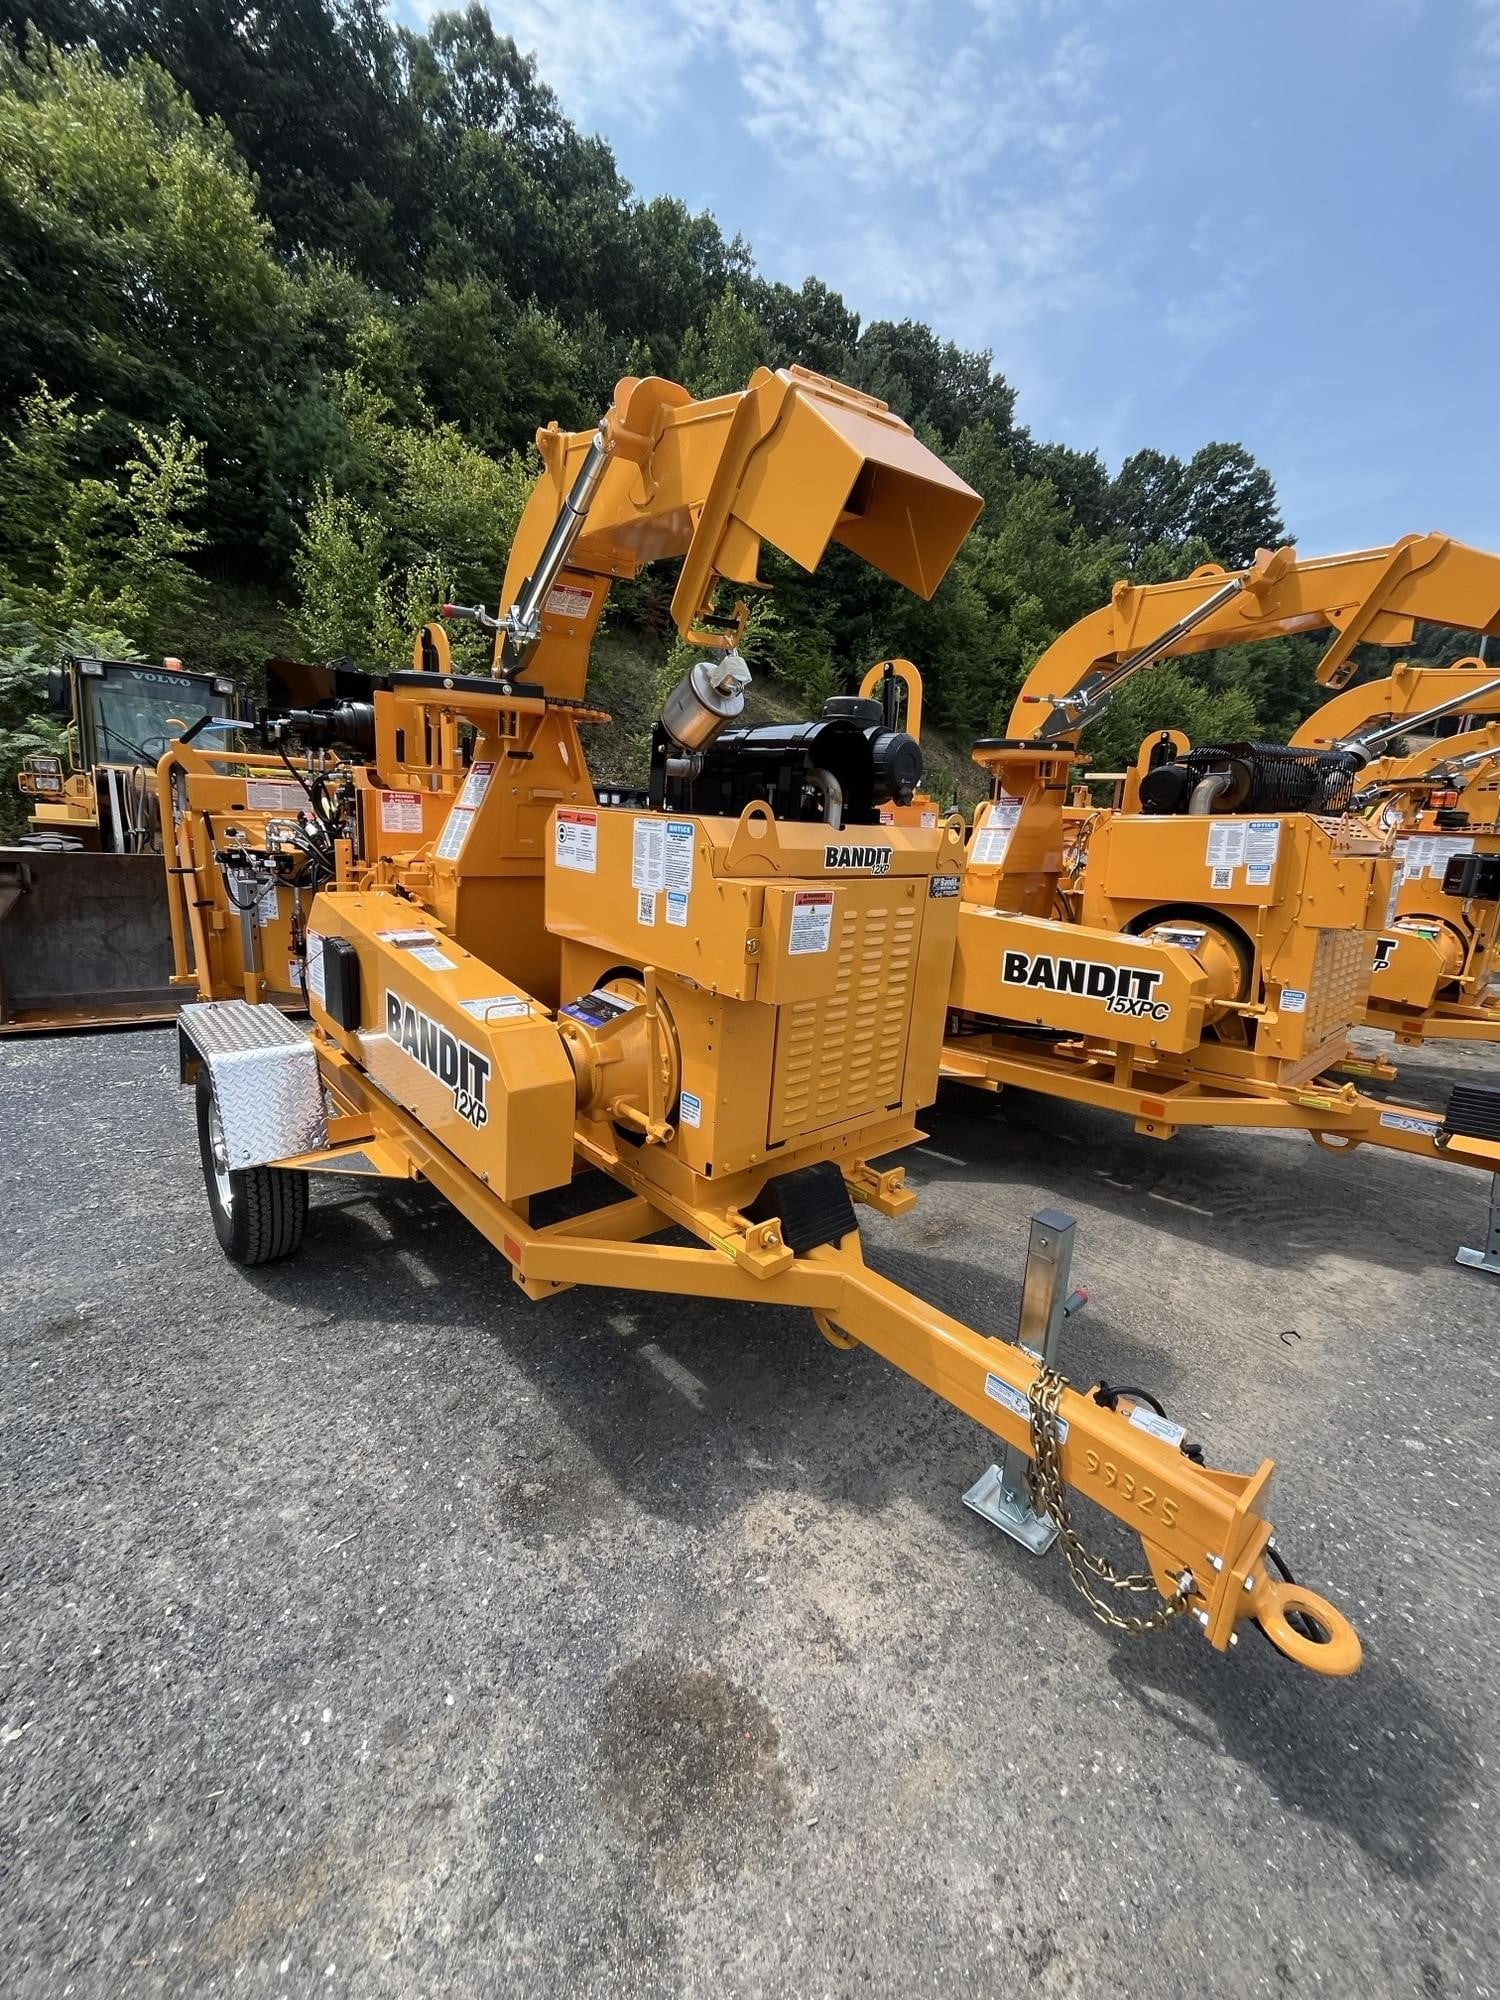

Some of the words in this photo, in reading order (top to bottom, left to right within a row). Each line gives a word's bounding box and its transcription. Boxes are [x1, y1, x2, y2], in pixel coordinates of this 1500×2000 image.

[129, 670, 191, 687] VOLVO
[669, 825, 691, 834] NOTICE
[825, 846, 892, 868] BANDIT
[871, 864, 890, 875] 12XP
[1003, 952, 1161, 1001] BANDIT
[1105, 995, 1169, 1020] 15XPC
[387, 991, 489, 1104] BANDIT
[454, 1087, 487, 1129] 12XP
[1085, 1449, 1180, 1528] 99325
